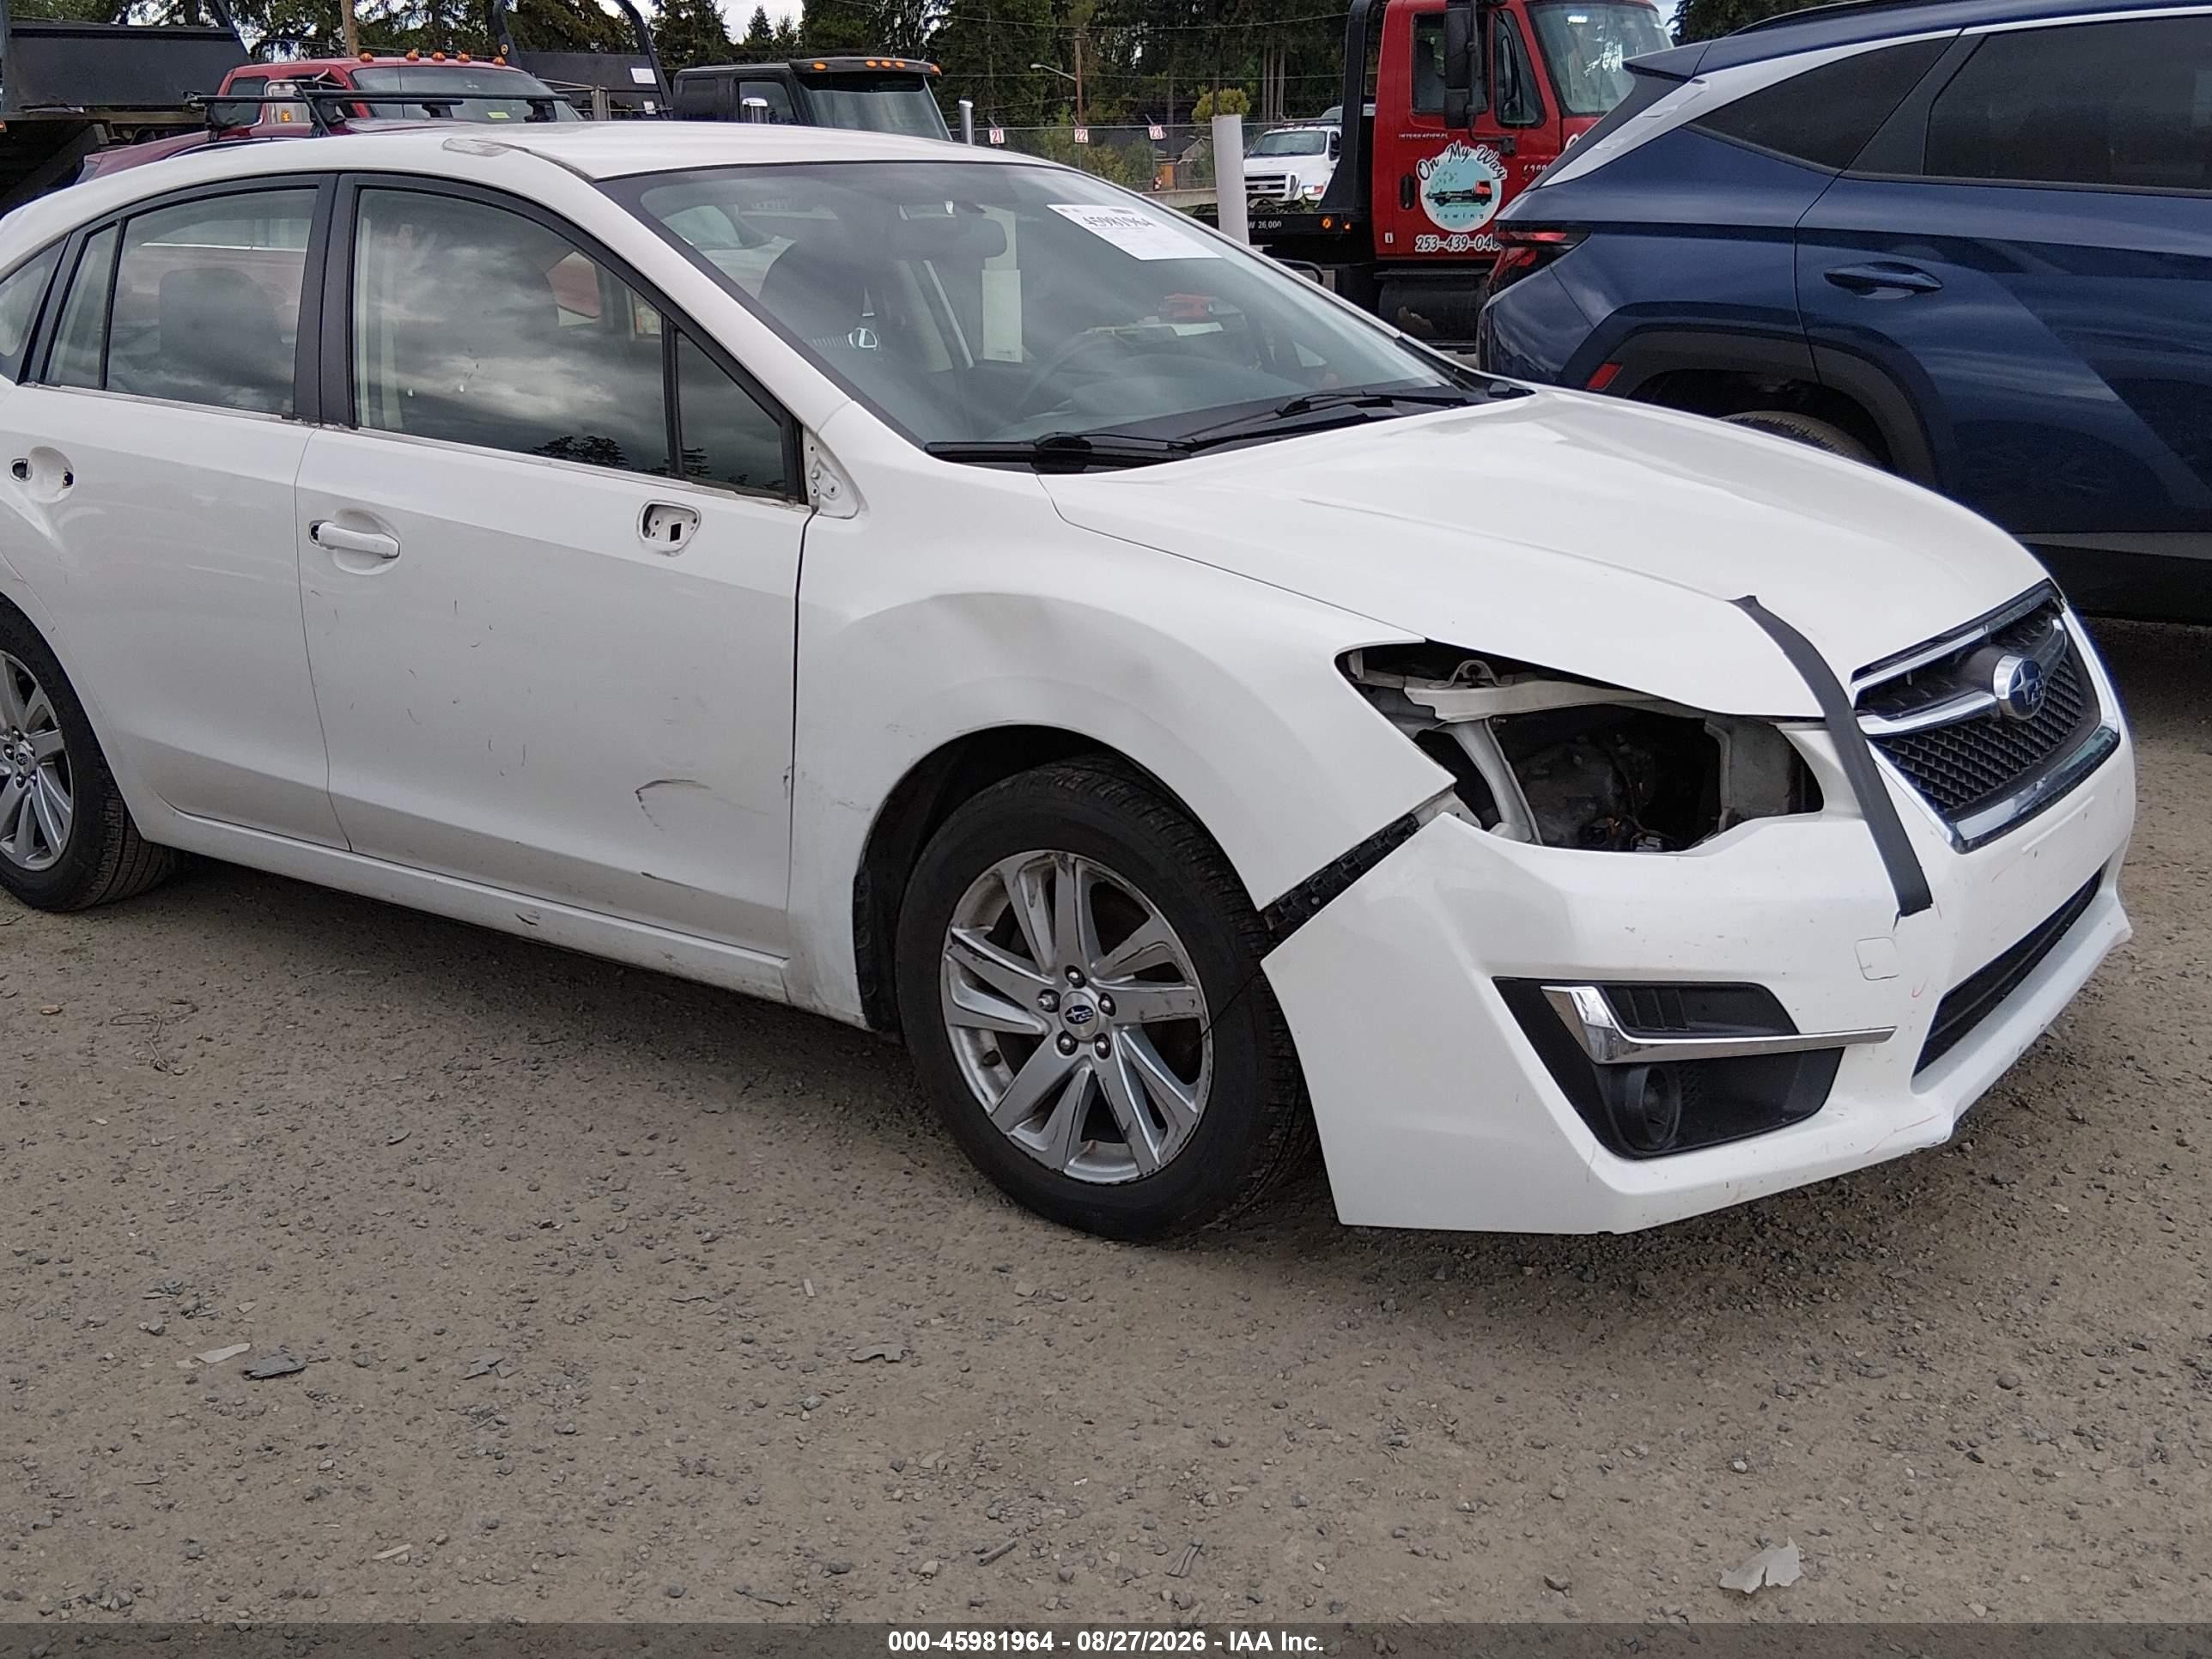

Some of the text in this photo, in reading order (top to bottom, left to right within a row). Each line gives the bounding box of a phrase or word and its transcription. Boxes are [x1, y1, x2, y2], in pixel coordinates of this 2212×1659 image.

[992, 131, 1002, 143] 21
[1075, 131, 1087, 142] 22
[1151, 126, 1163, 139] 23
[1417, 140, 1507, 181] On My Way
[1082, 216, 1157, 228] 45981964
[1258, 220, 1282, 230] 26,000
